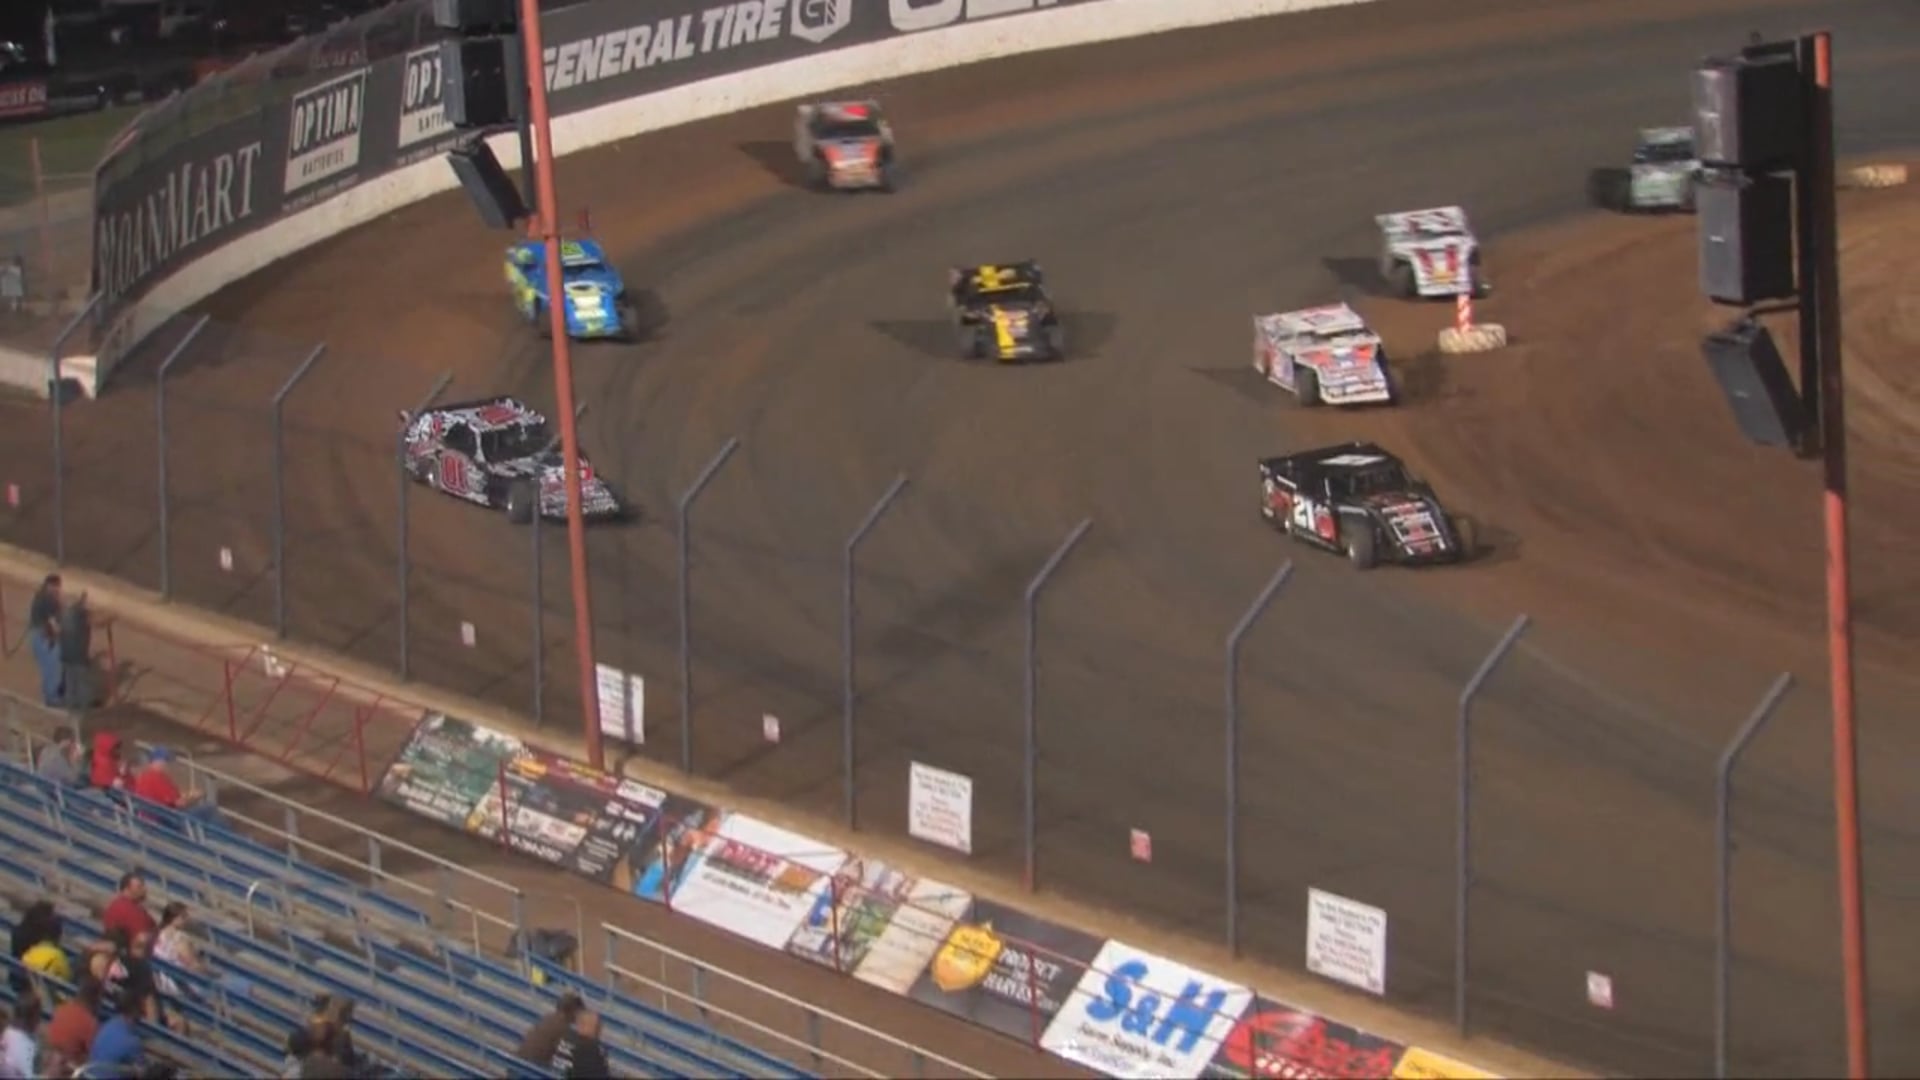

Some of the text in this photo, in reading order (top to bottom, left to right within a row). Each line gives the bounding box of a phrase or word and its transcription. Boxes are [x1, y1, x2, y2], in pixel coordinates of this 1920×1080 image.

[699, 0, 787, 53] TIRE
[293, 84, 360, 152] OPTIMA
[1293, 494, 1316, 531] 21
[1085, 959, 1228, 1057] S&H
